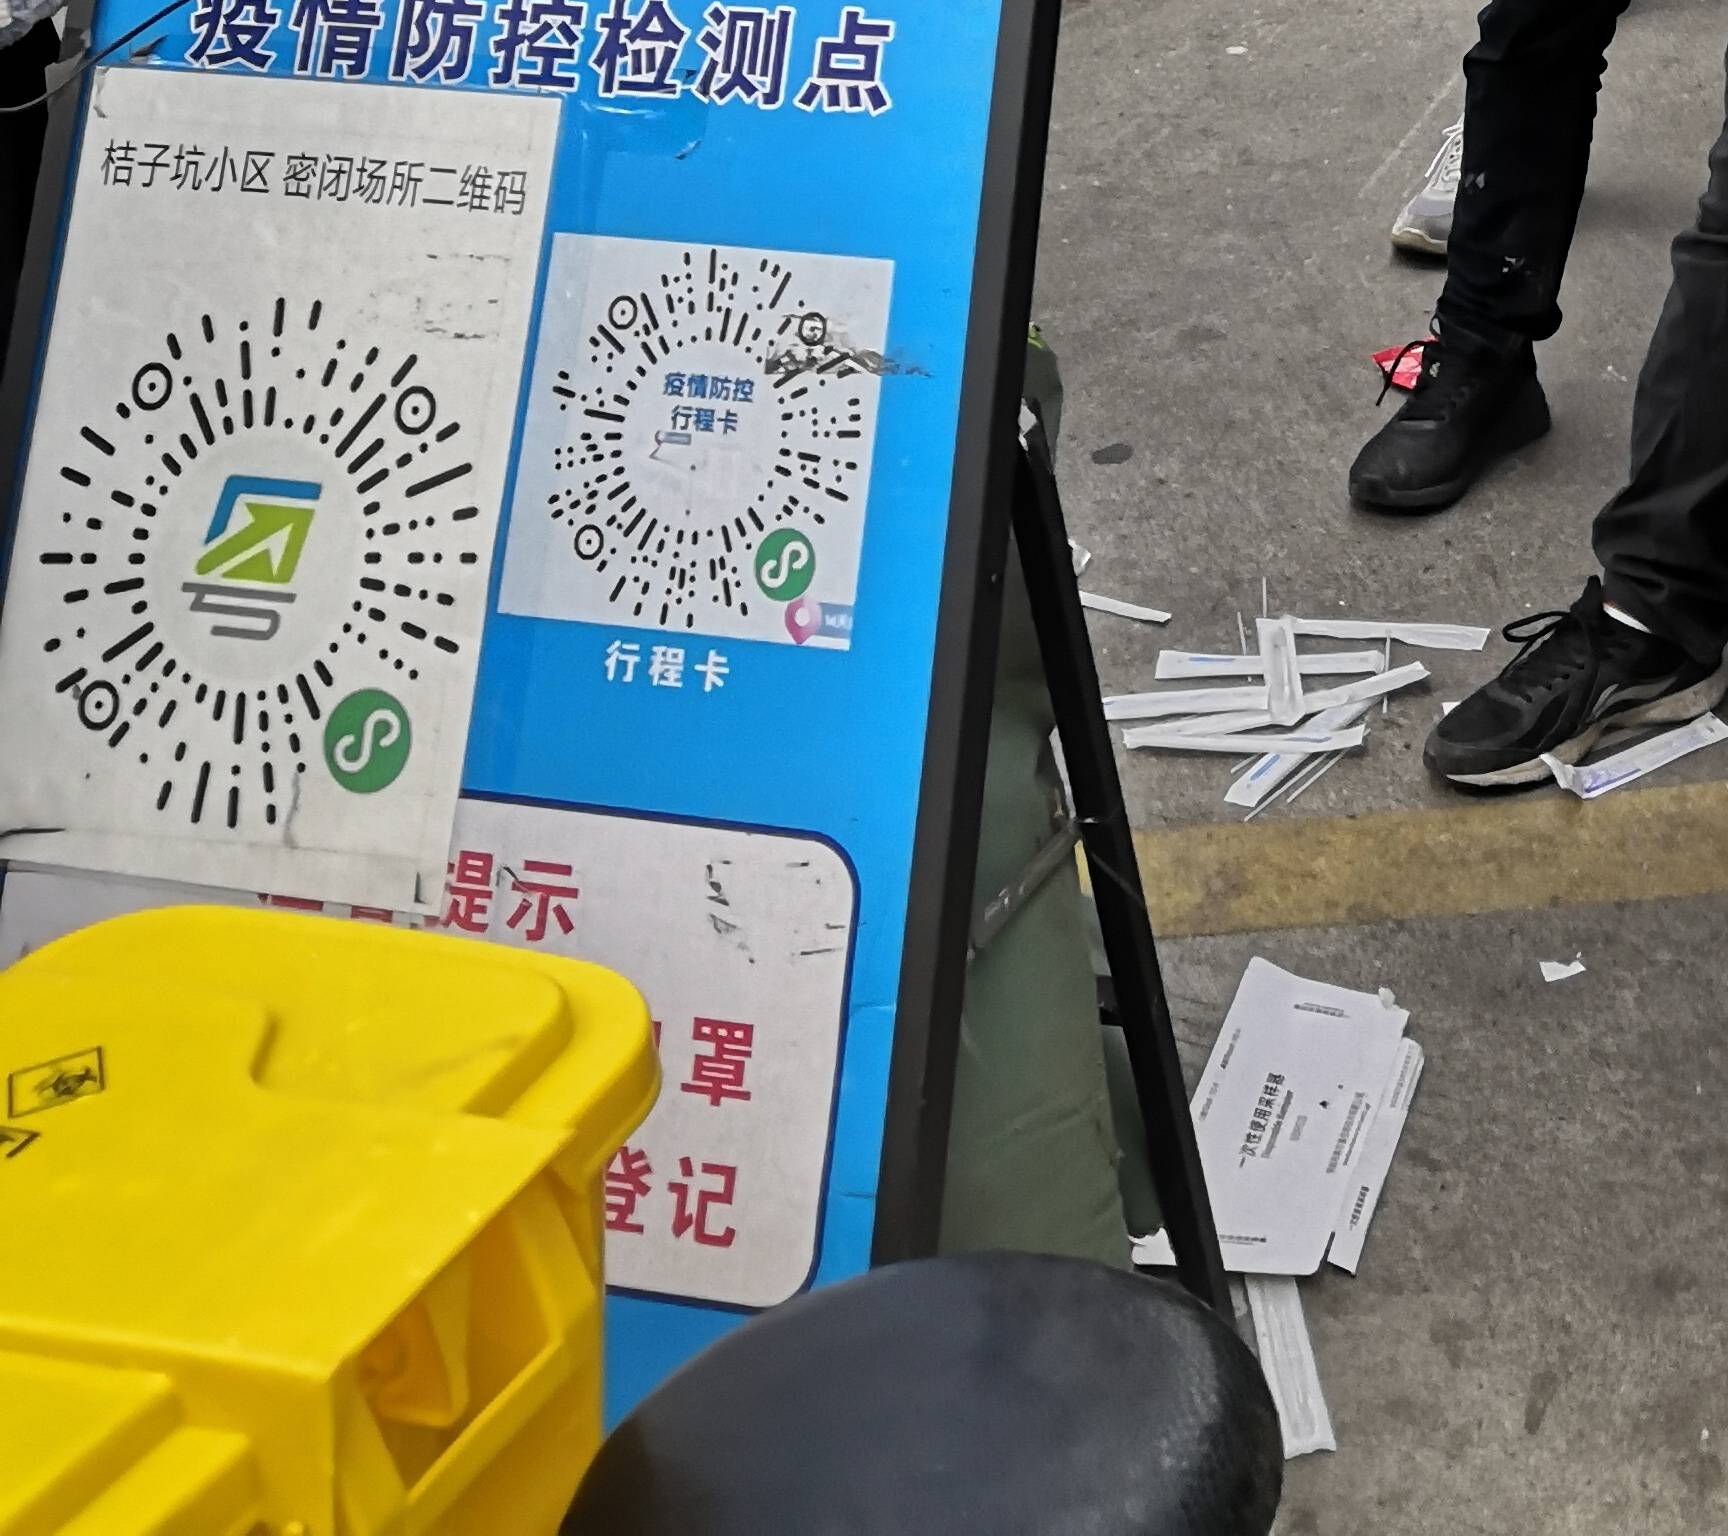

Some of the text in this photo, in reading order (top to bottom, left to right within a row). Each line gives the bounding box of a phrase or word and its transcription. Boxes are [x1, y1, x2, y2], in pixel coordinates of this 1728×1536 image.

[100, 137, 529, 219] 桔子坑小区 密闭场所二维码
[662, 371, 755, 403] 疫情防控
[670, 405, 739, 435] 行程卡
[603, 639, 731, 693] 行程卡
